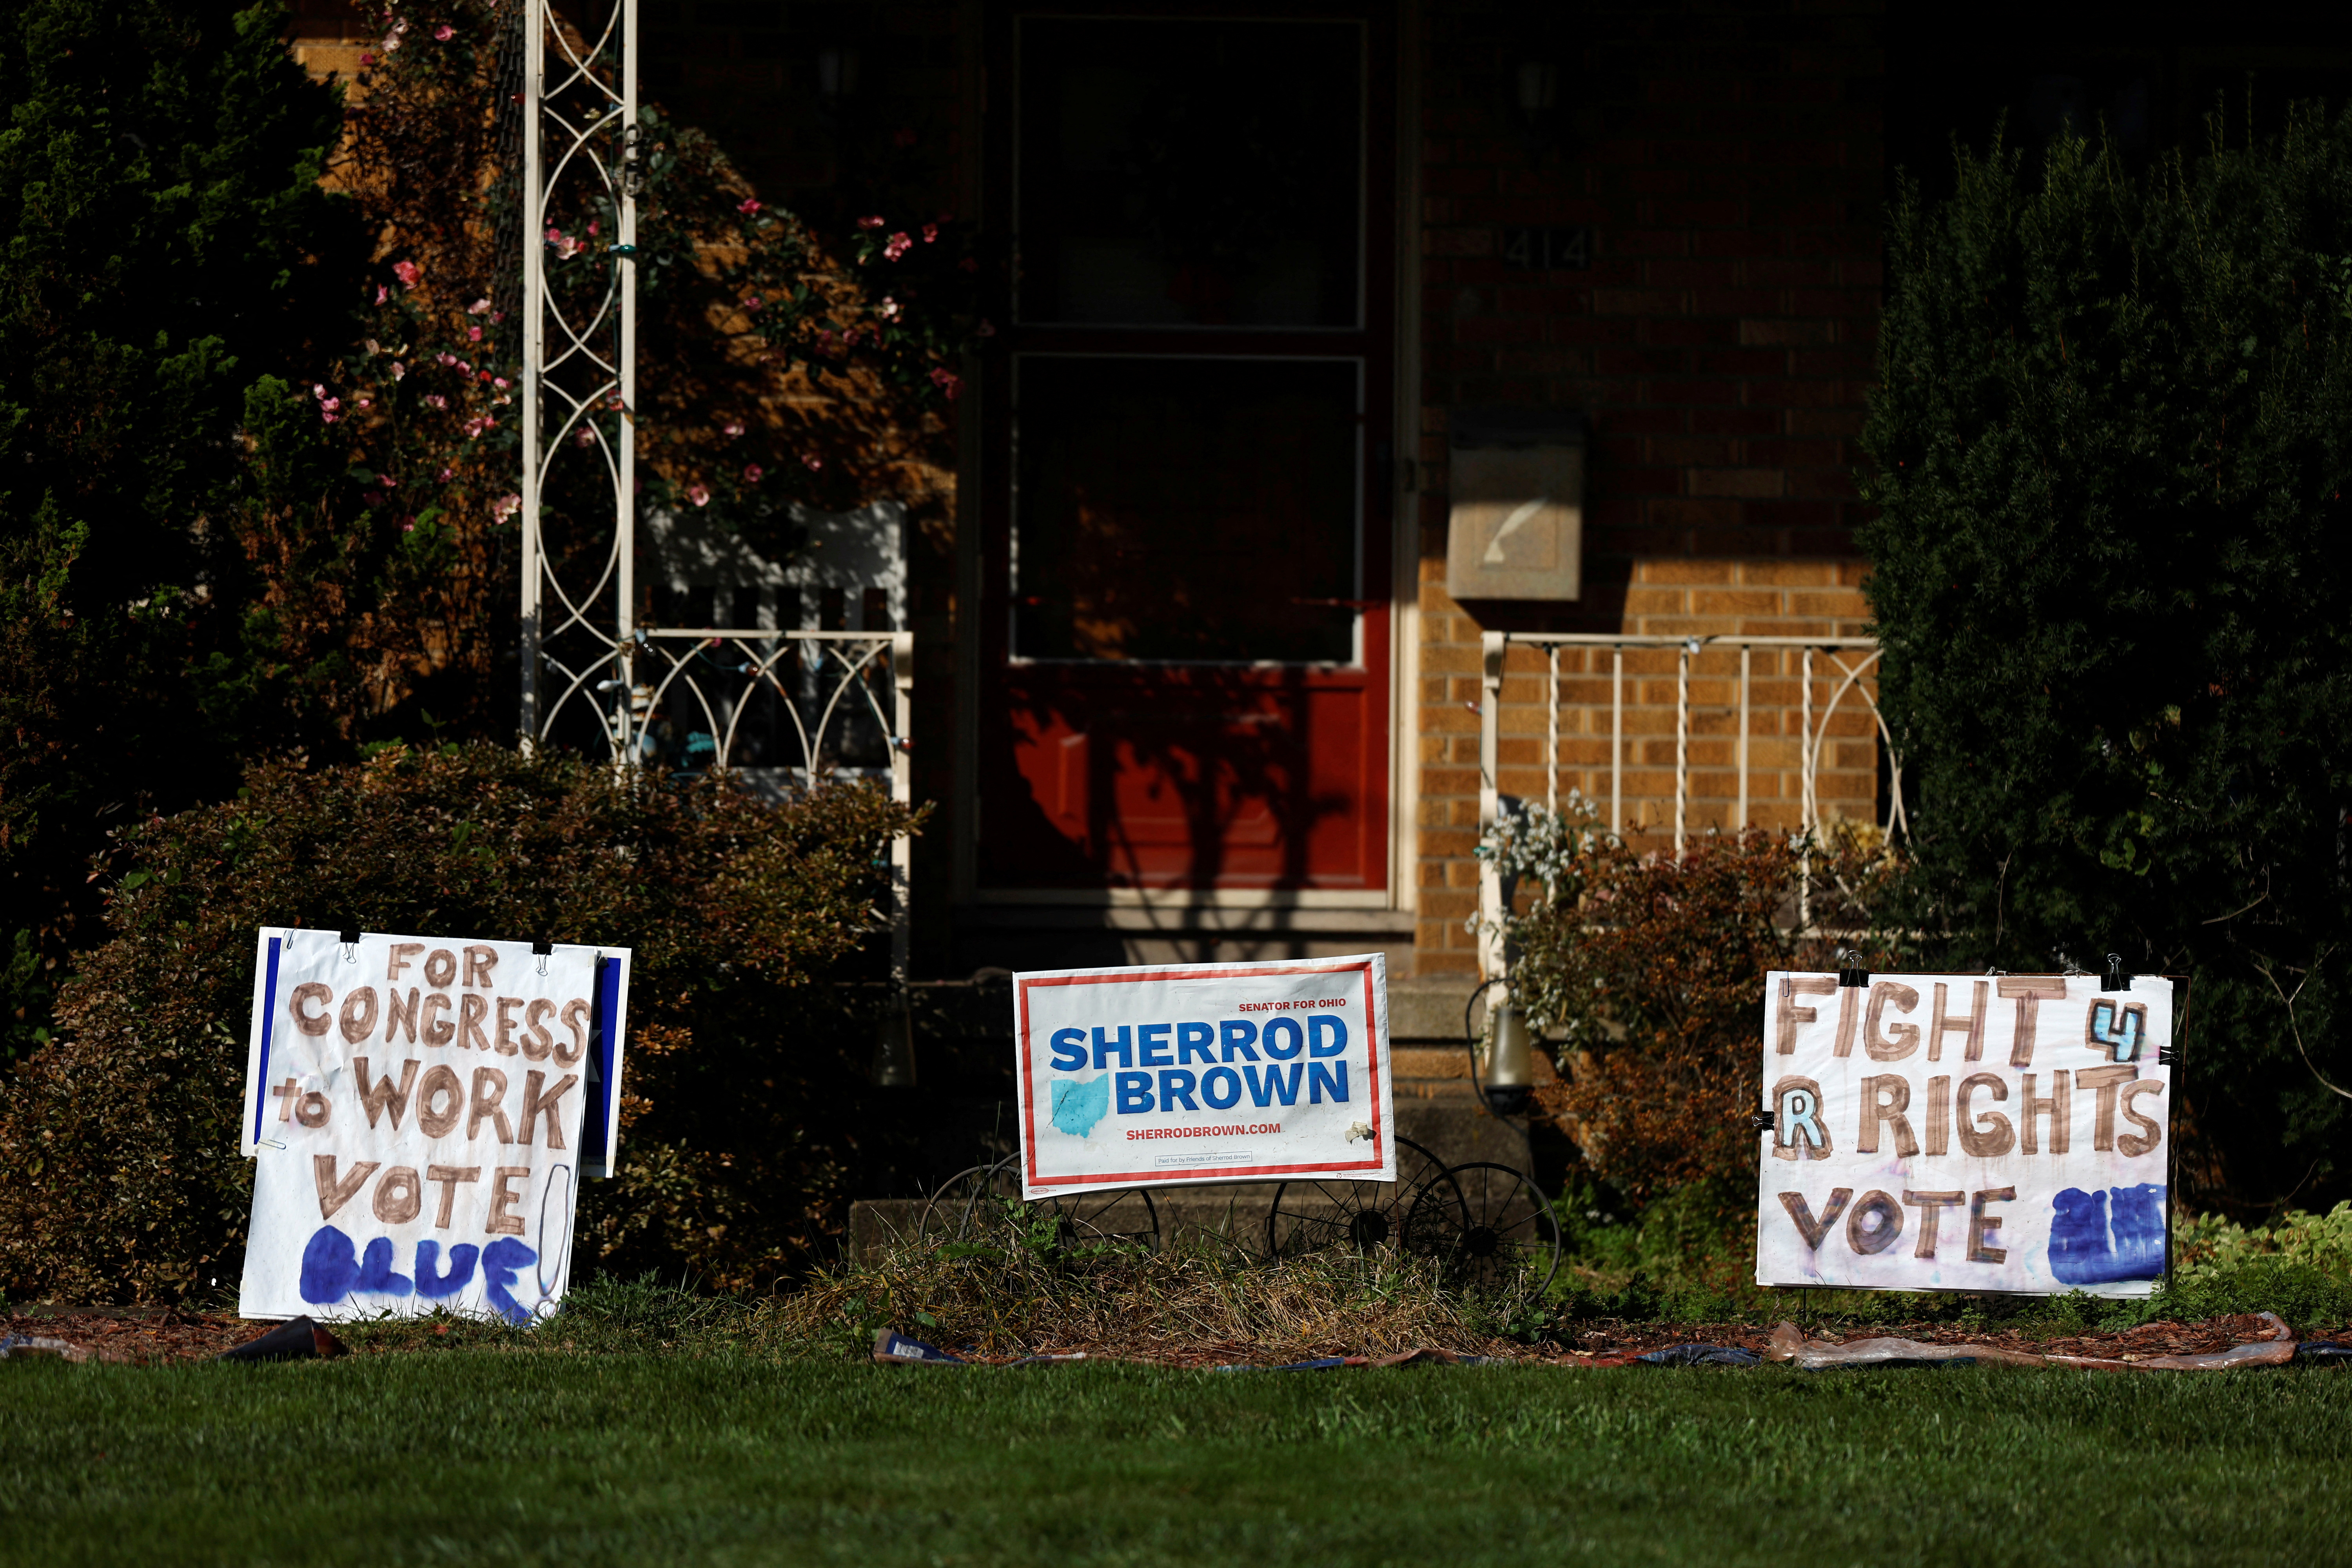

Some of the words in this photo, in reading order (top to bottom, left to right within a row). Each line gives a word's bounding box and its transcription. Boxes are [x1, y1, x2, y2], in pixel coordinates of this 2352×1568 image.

[387, 943, 499, 987] FOR
[289, 982, 592, 1068] CONGRESS
[1049, 1014, 1348, 1071] SHERROD
[1239, 1001, 1291, 1012] SENATOR
[1294, 1000, 1316, 1009] FOR
[1319, 998, 1346, 1008] OHIO
[1776, 976, 2067, 1067] FIGHT
[2085, 998, 2148, 1063] 4
[272, 1077, 332, 1129] to
[353, 1056, 579, 1150] WORK
[1115, 1060, 1349, 1114] BROWN
[1771, 1074, 1834, 1161] R
[1857, 1064, 2165, 1158] RIGHTS
[1126, 1122, 1281, 1141] SHERRODBROWN.COM
[313, 1154, 530, 1236] VOTE
[1778, 1185, 2017, 1264] VOTE
